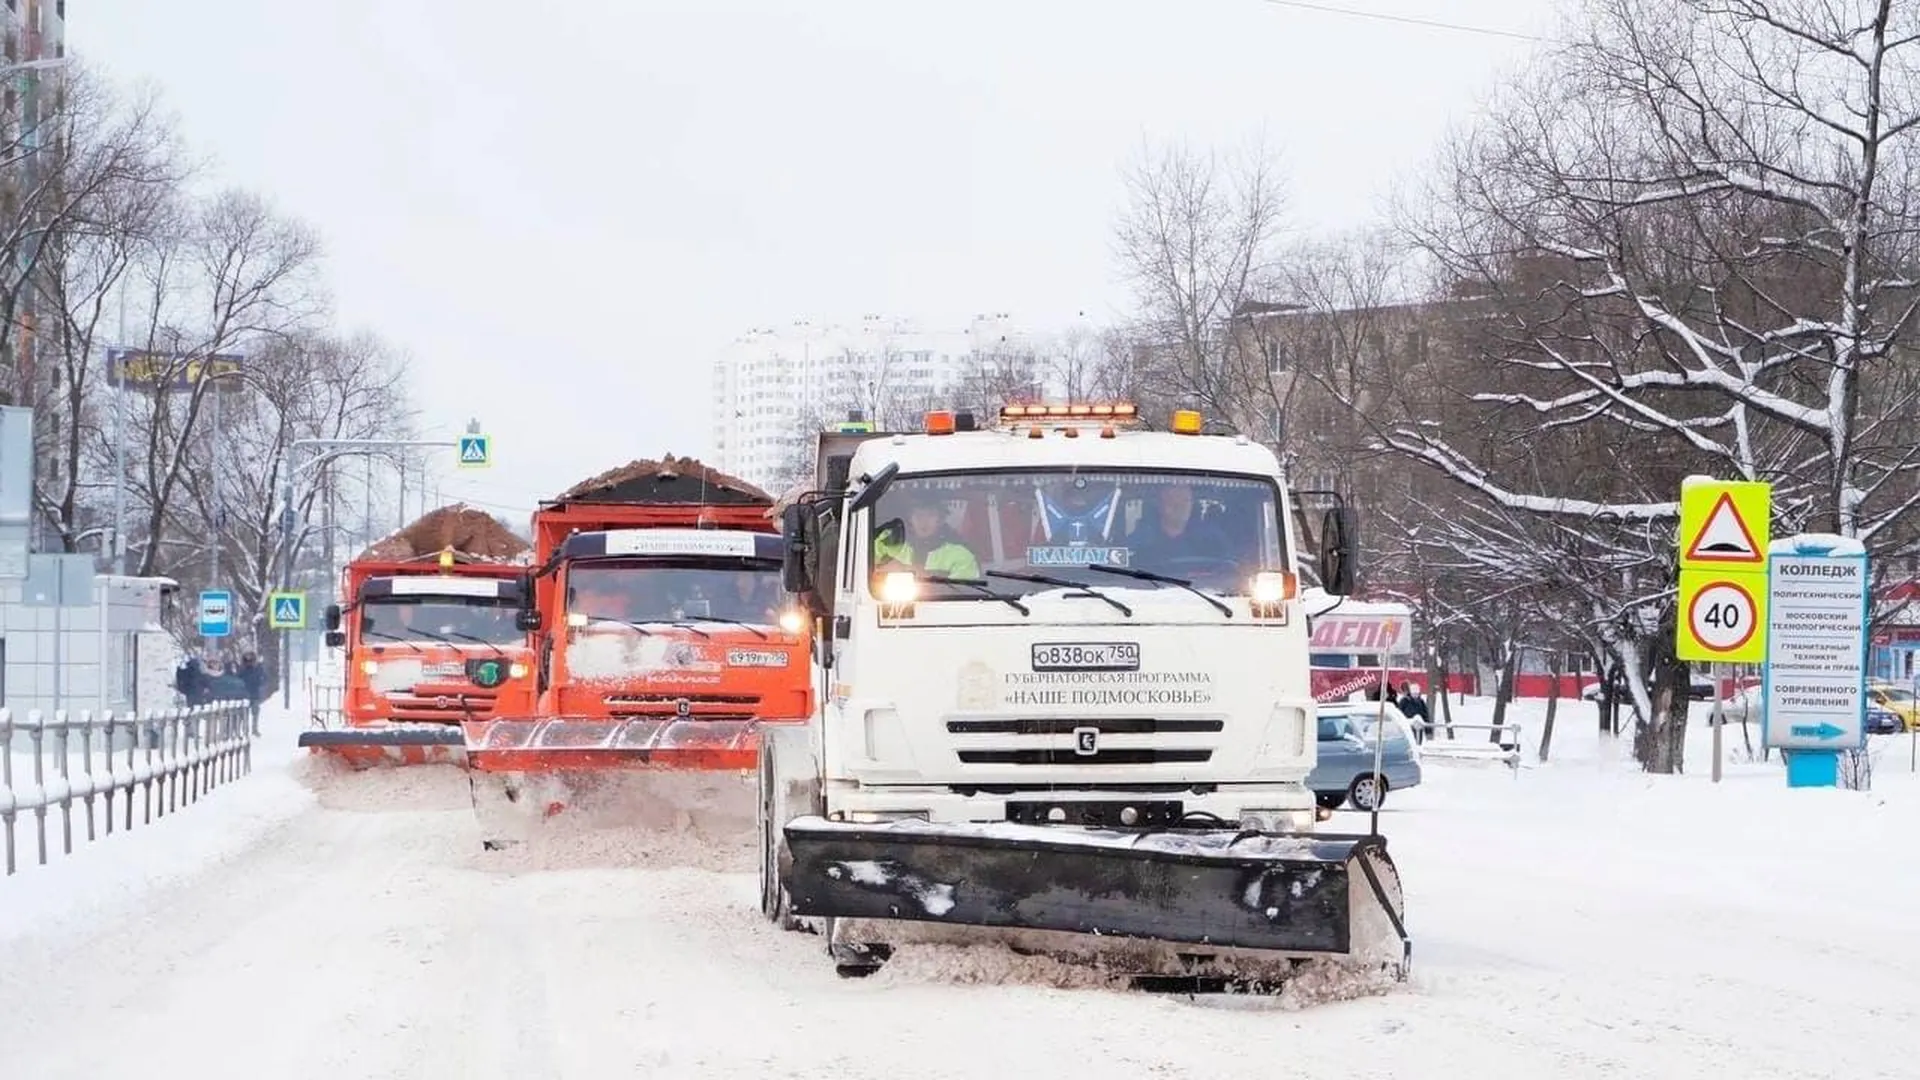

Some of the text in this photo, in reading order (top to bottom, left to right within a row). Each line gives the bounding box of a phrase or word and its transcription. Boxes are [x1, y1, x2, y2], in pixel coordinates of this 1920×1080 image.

[1780, 565, 1857, 577] КОЛЛЕДЖ
[1704, 603, 1739, 629] 40
[1005, 672, 1211, 684] ГУБЕРНАТОРСКАЯ ПРОГРАММА
[1775, 685, 1857, 695] СОВРЕМЕННОГО
[1005, 689, 1212, 705] «НАШЕ ПОДМОСКОВЬЕ»
[1781, 698, 1849, 707] УПРАВЛЕНИЯ
